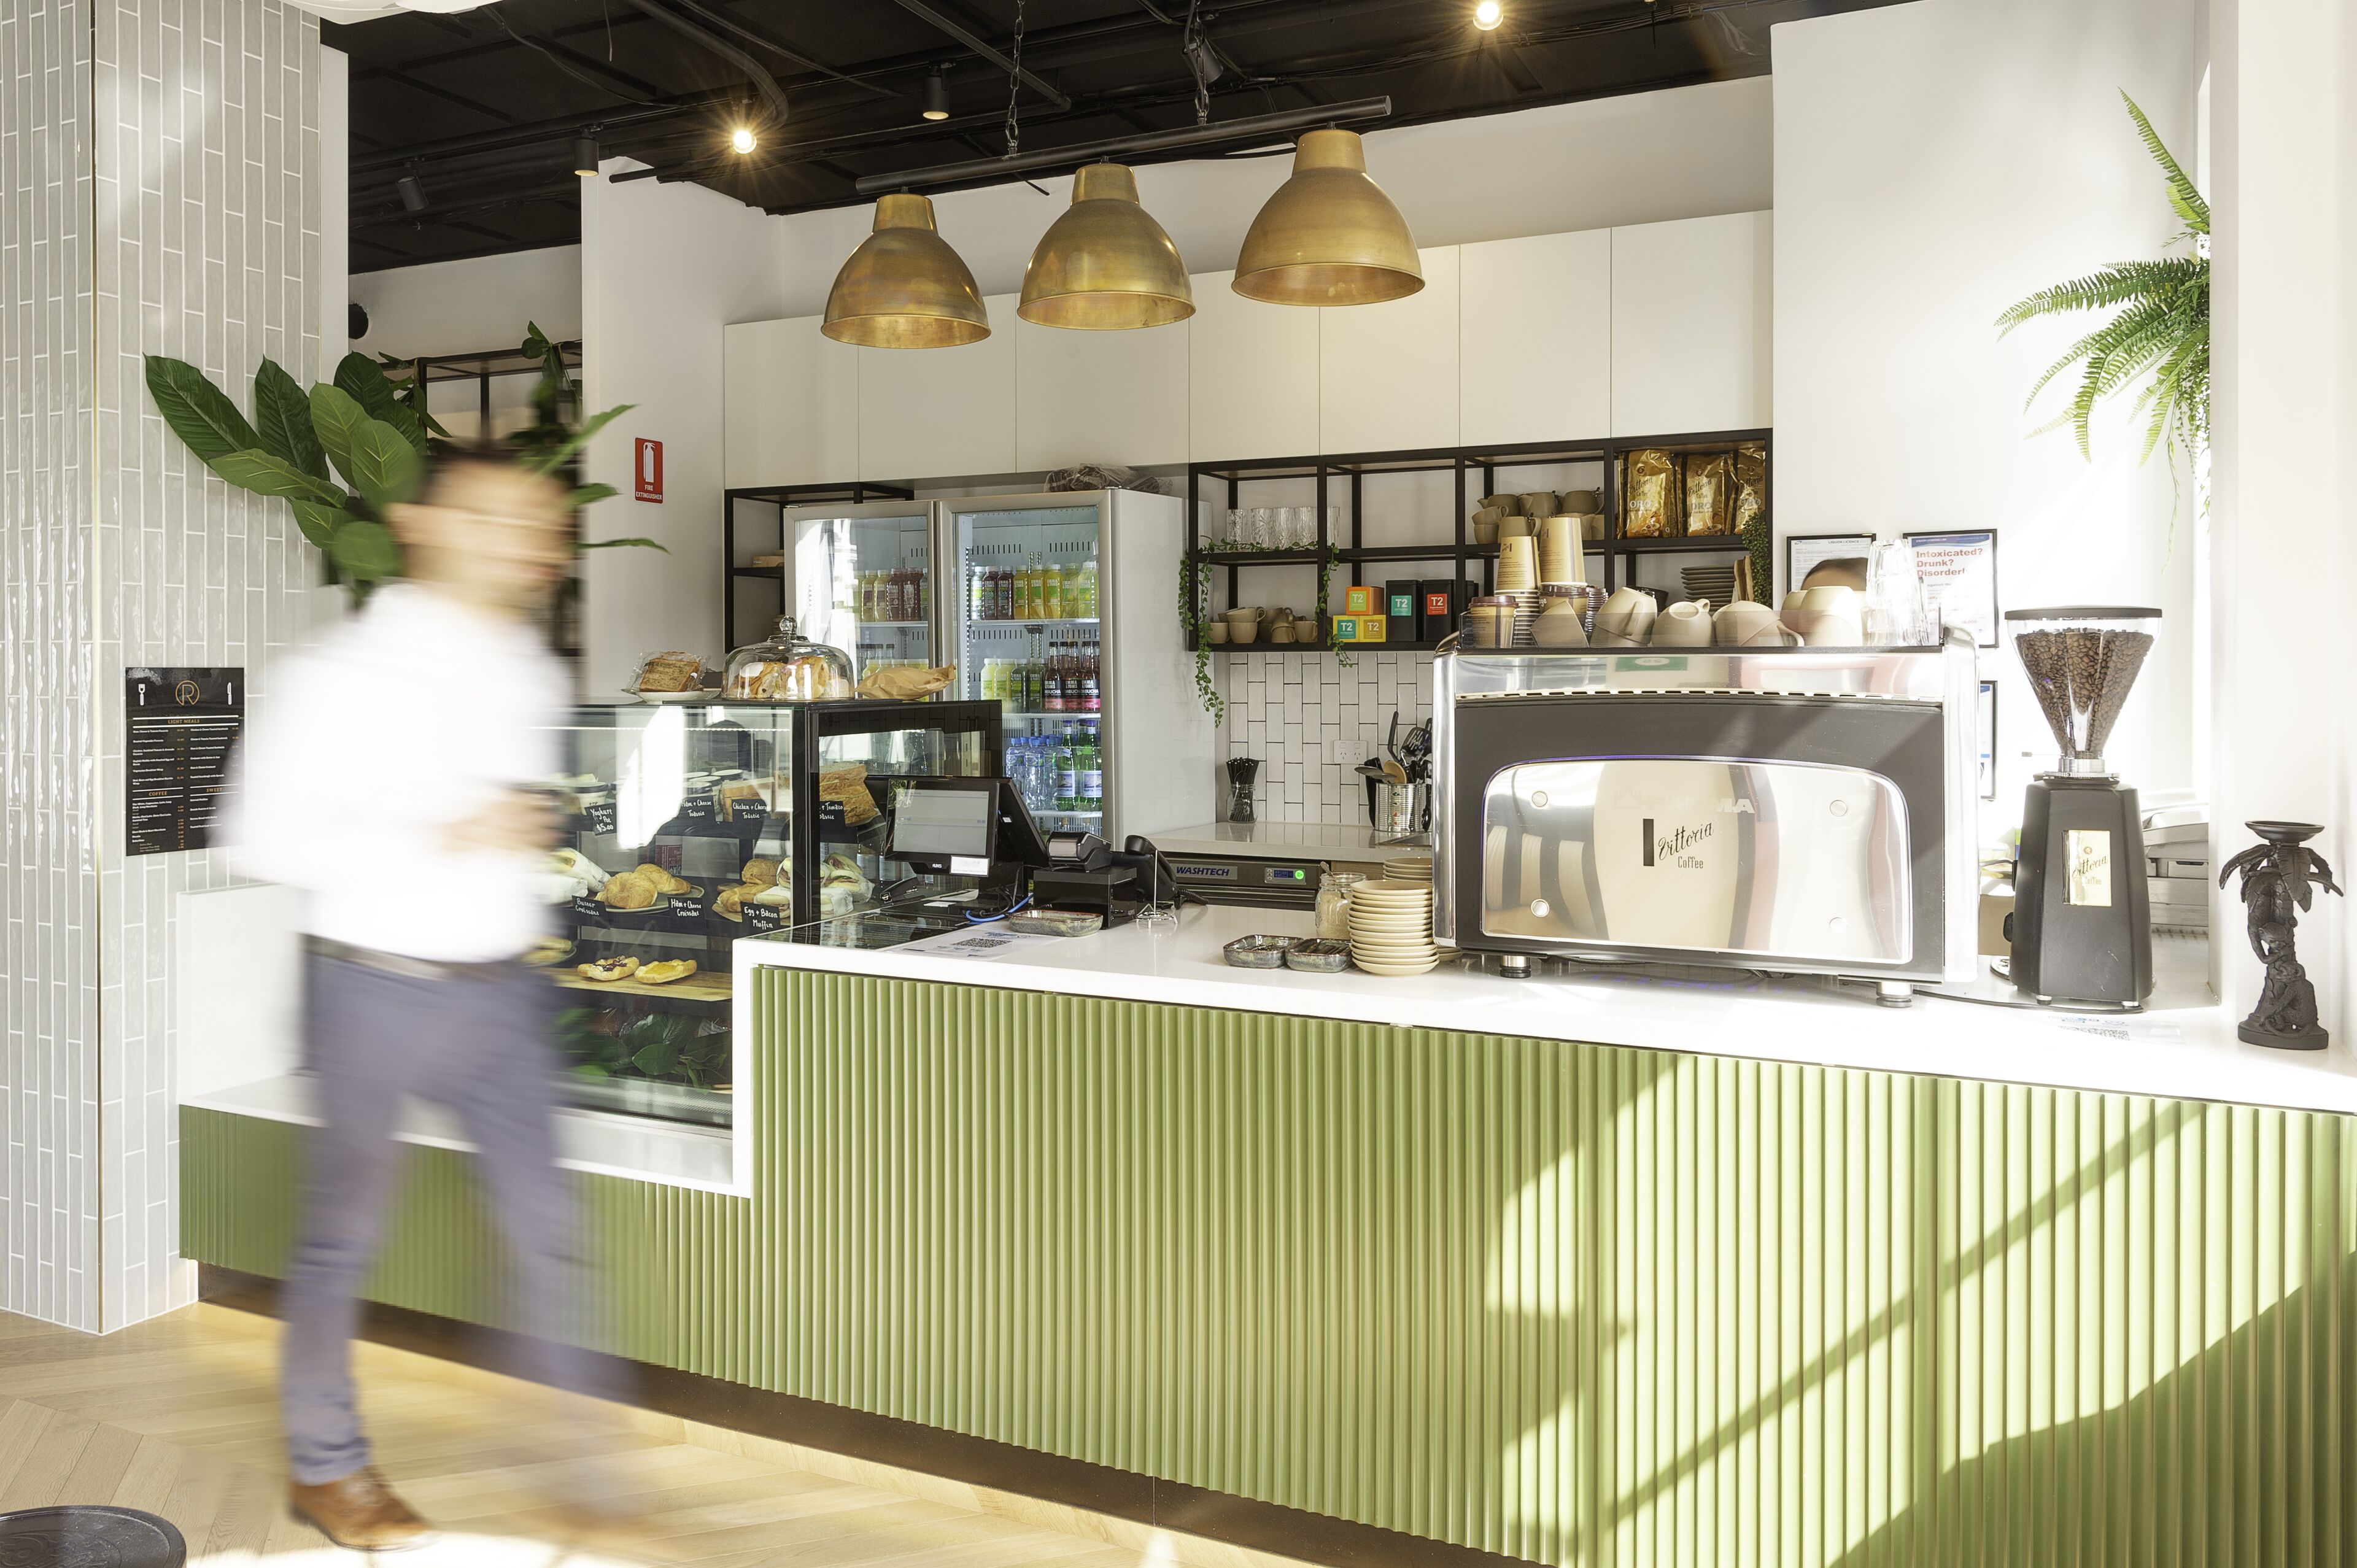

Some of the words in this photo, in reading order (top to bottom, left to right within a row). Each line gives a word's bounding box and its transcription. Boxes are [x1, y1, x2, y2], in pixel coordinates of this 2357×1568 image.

[636, 492, 662, 500] EXTINGUISHER
[1916, 548, 1983, 558] Intoxicated?
[1352, 594, 1363, 603] T2
[1395, 598, 1407, 608] T2
[1431, 597, 1443, 606] T2
[1341, 622, 1353, 631] T2
[1367, 622, 1379, 631] T2
[732, 801, 749, 810] Chicken
[825, 801, 843, 811] Tomato
[590, 807, 613, 819] Yoghurt
[1658, 822, 1714, 860] Vittoria
[1678, 856, 1703, 869] Coffee
[1176, 866, 1229, 876] WASHTECH
[576, 898, 596, 908] Butter
[671, 898, 683, 908] Ham
[575, 905, 600, 917] Croissant
[744, 906, 755, 916] Egg
[761, 907, 778, 918] Bacon
[753, 919, 773, 929] Muffin
